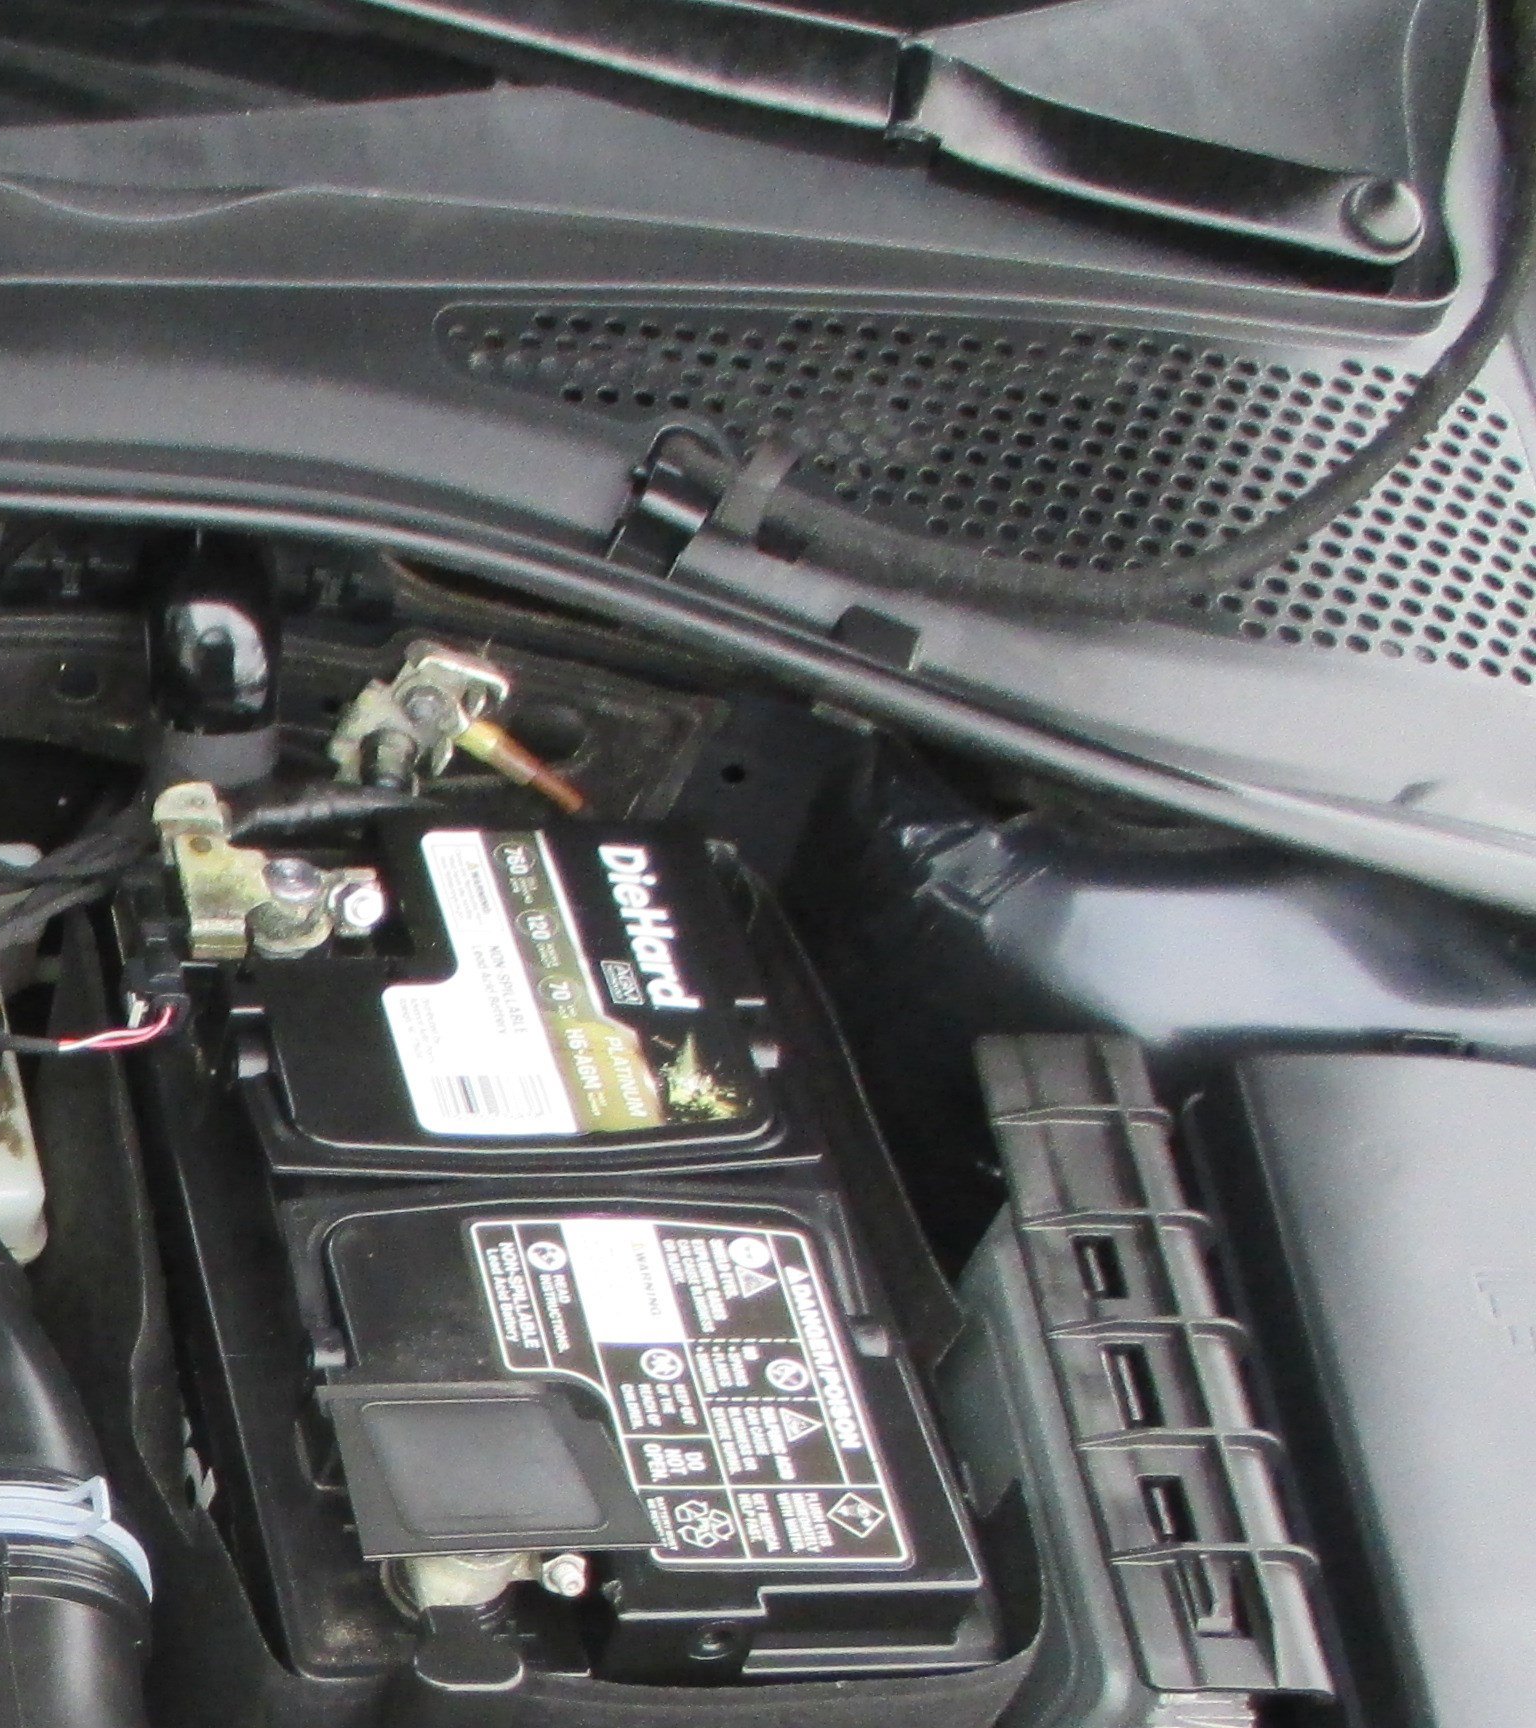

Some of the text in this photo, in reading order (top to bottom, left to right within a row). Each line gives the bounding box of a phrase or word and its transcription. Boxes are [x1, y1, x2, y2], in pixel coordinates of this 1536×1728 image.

[522, 914, 555, 940] 120
[596, 844, 703, 1011] DieHard
[546, 981, 574, 1001] 70
[562, 1026, 604, 1090] H6-AGM
[601, 1035, 646, 1117] PLATINUM
[485, 1248, 505, 1274] Lead
[631, 1252, 664, 1316] WARNING
[496, 1241, 542, 1349] NON-SPILLABLE
[550, 1273, 573, 1304] READ
[788, 1283, 863, 1448] DANGER/POISON
[662, 1448, 688, 1474] NOT
[682, 1451, 708, 1470] DO
